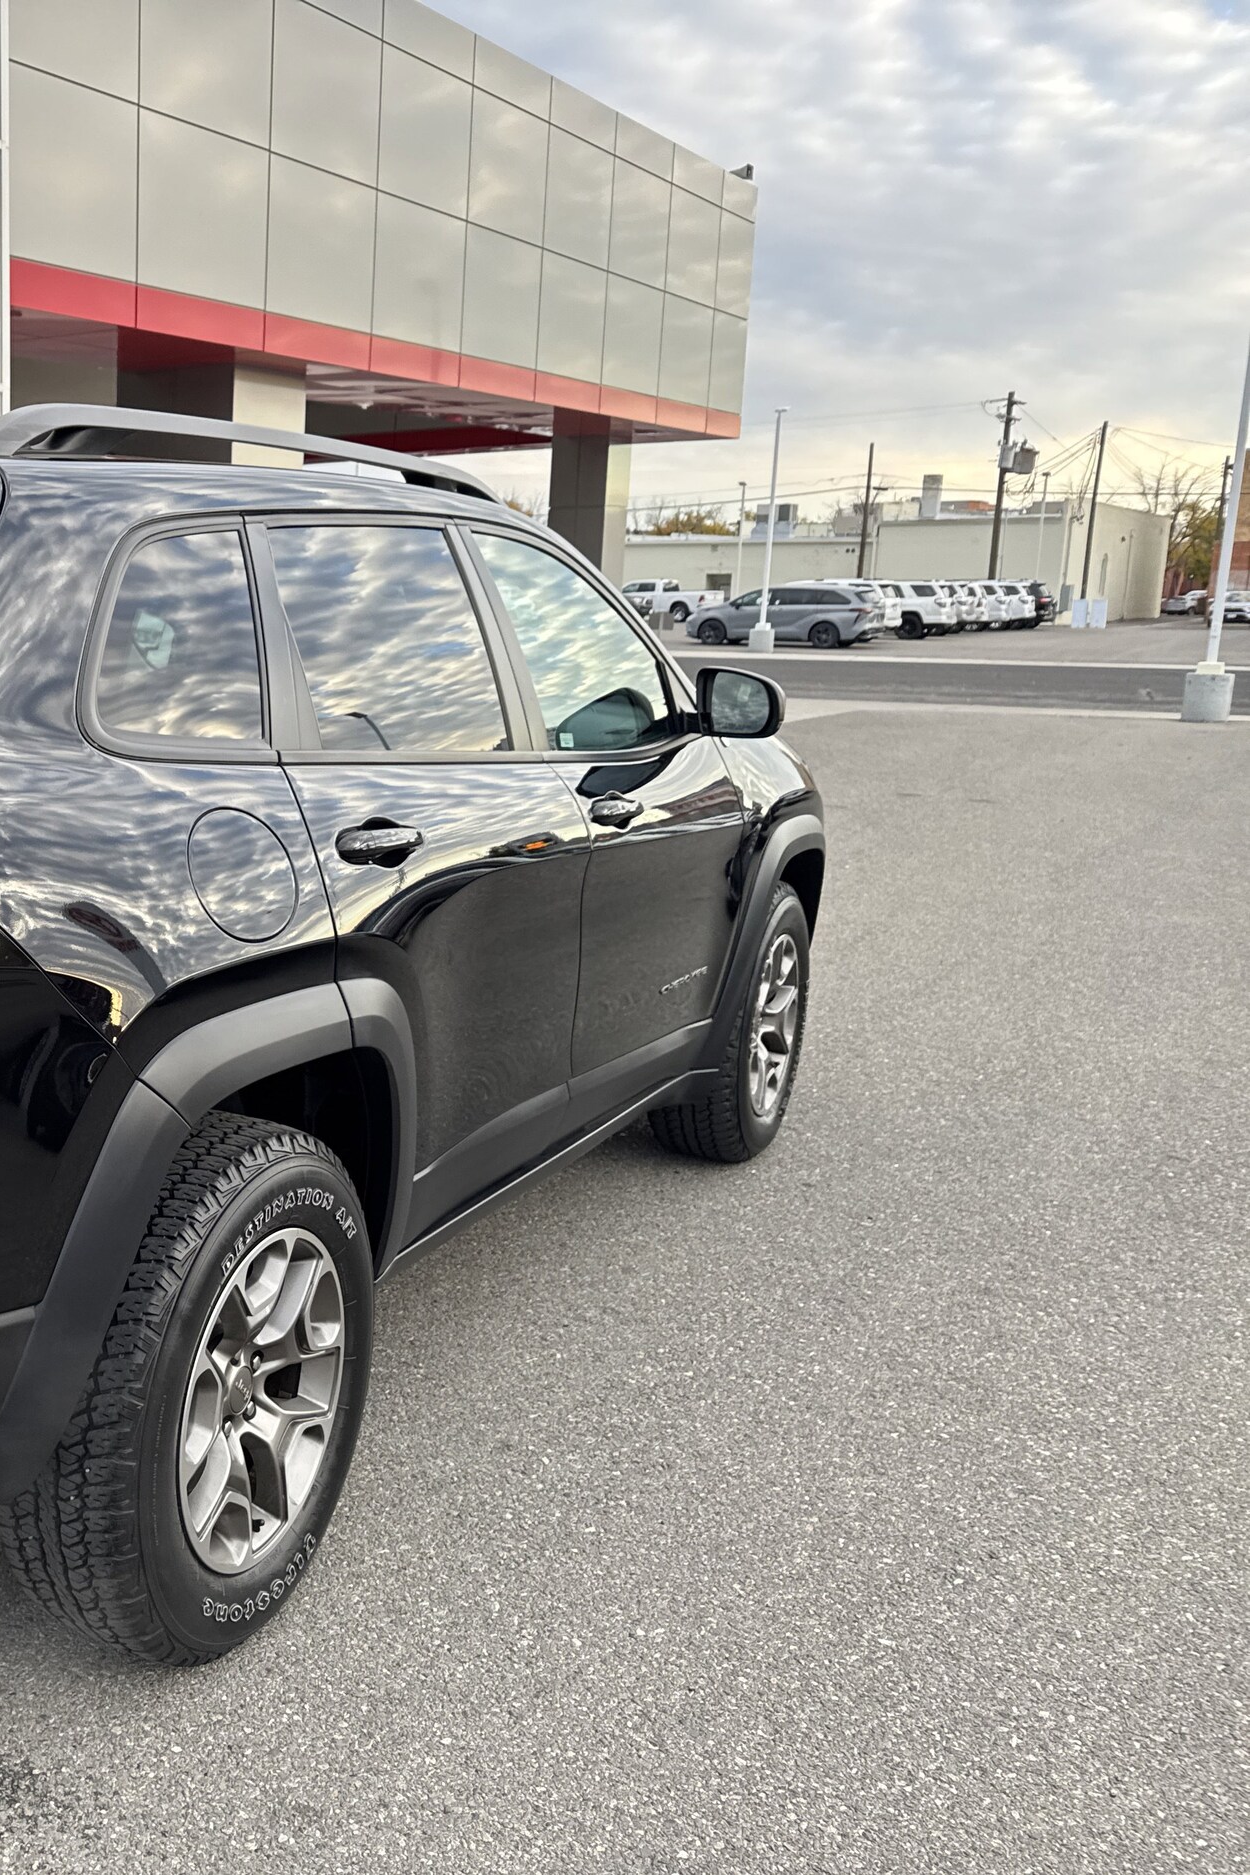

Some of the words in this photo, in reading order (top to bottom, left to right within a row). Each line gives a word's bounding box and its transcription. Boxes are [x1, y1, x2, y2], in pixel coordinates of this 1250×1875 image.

[220, 1187, 335, 1278] DESTINATION
[335, 1206, 358, 1240] A/T
[201, 1532, 317, 1623] Firestone
